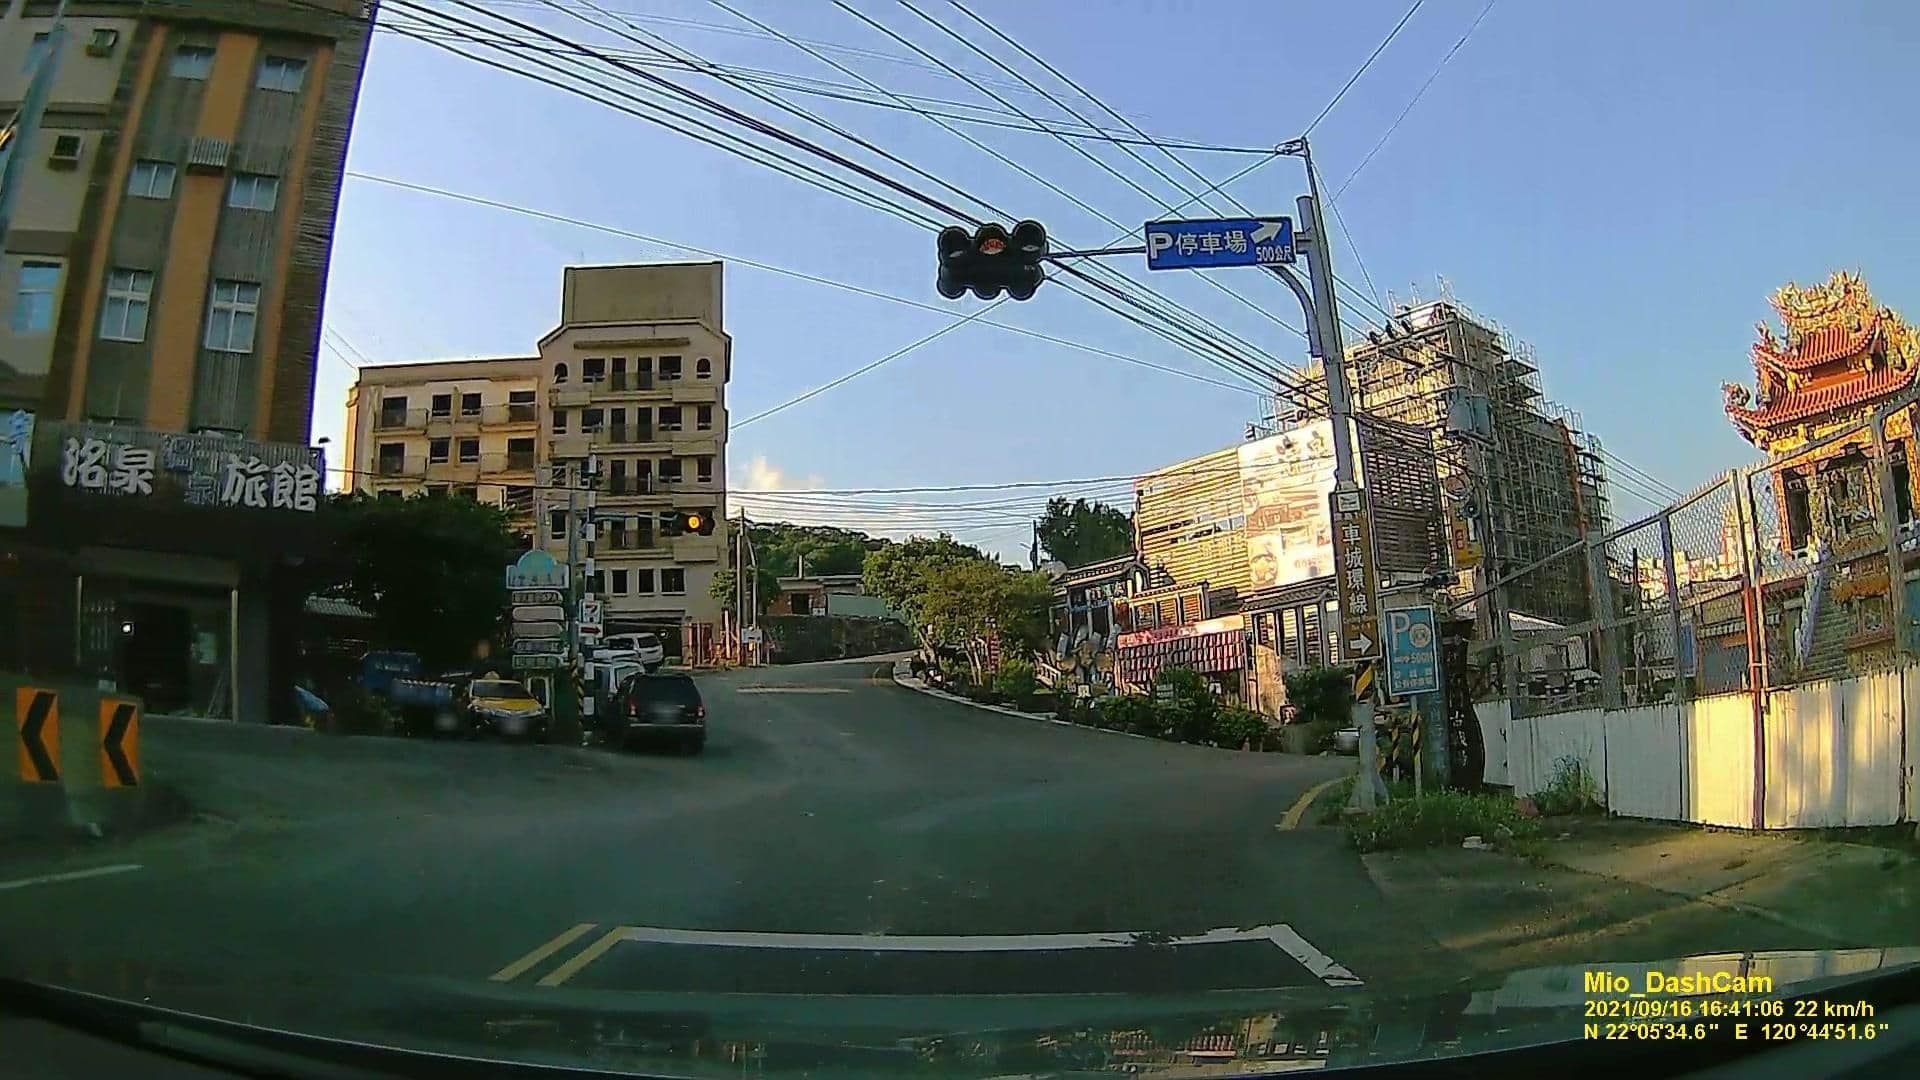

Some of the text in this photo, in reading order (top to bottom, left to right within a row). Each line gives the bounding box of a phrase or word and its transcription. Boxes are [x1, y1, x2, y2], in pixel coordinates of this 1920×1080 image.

[1175, 231, 1247, 256] 停車場
[1256, 246, 1292, 262] 500公尺
[221, 453, 320, 512] 旅館
[1341, 523, 1369, 615] 車城環線
